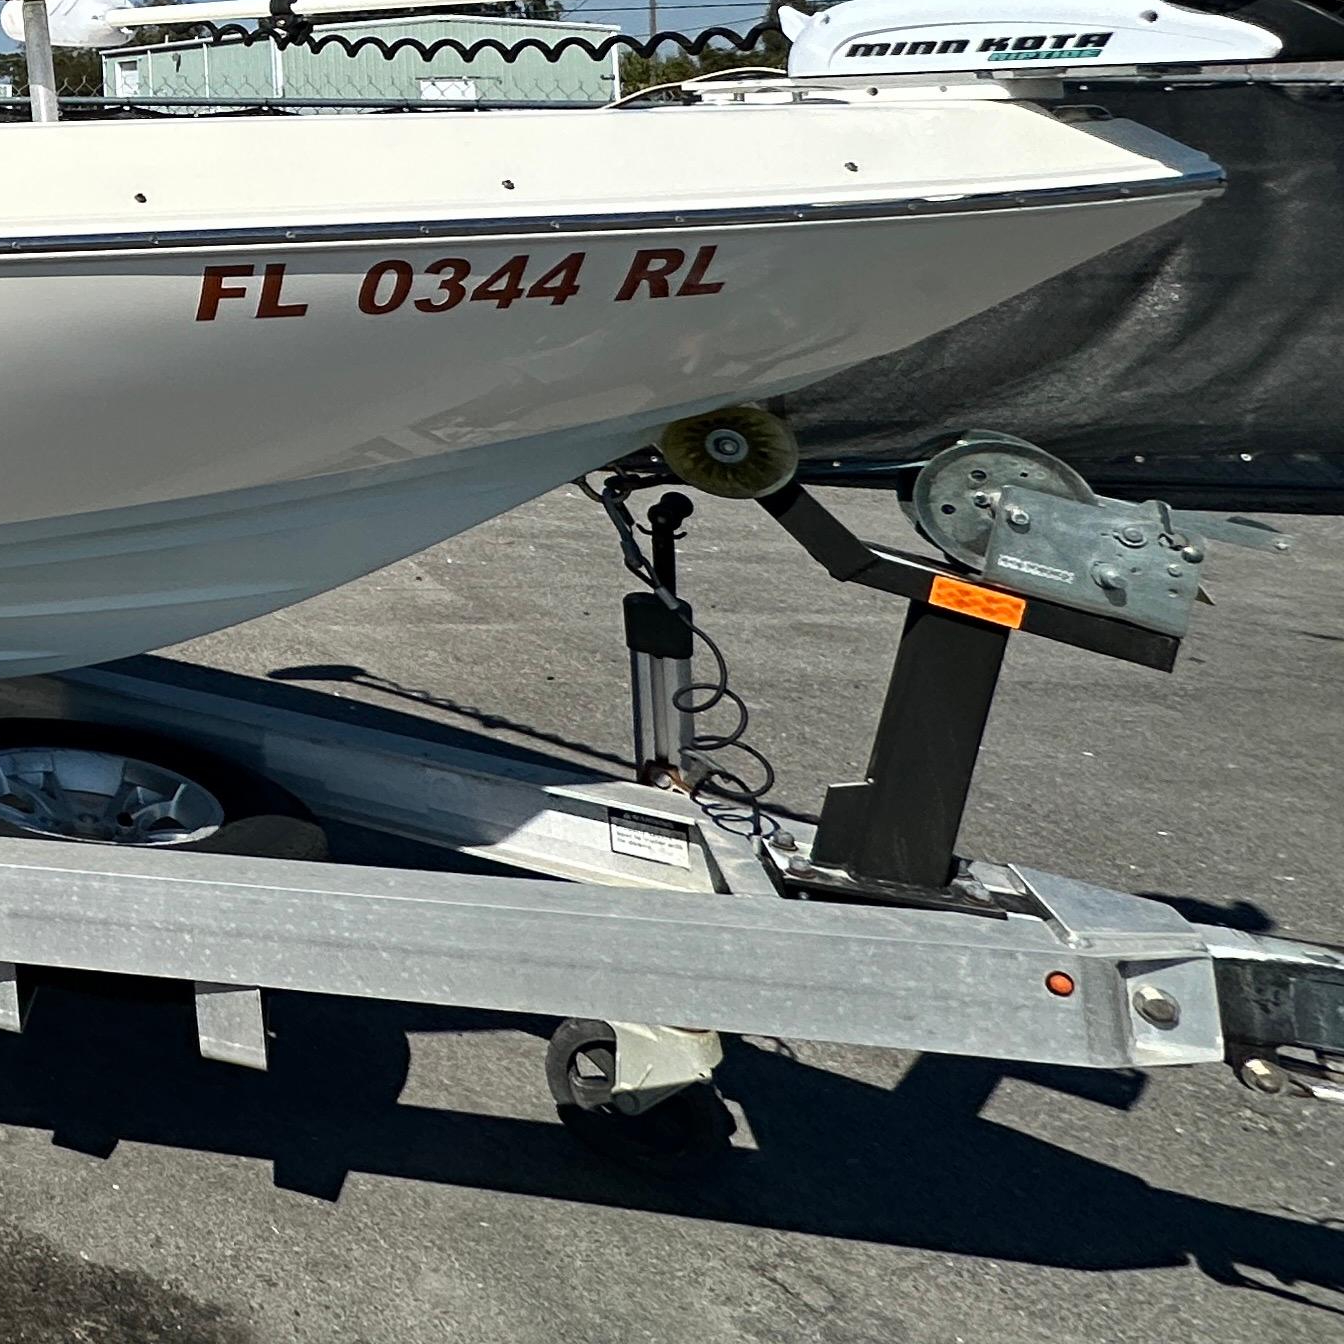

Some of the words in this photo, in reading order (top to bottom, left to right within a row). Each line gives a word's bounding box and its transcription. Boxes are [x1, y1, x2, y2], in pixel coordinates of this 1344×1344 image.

[976, 32, 1114, 52] KOTA
[195, 263, 308, 321] FL
[358, 252, 586, 316] 0344
[614, 245, 725, 301] RL
